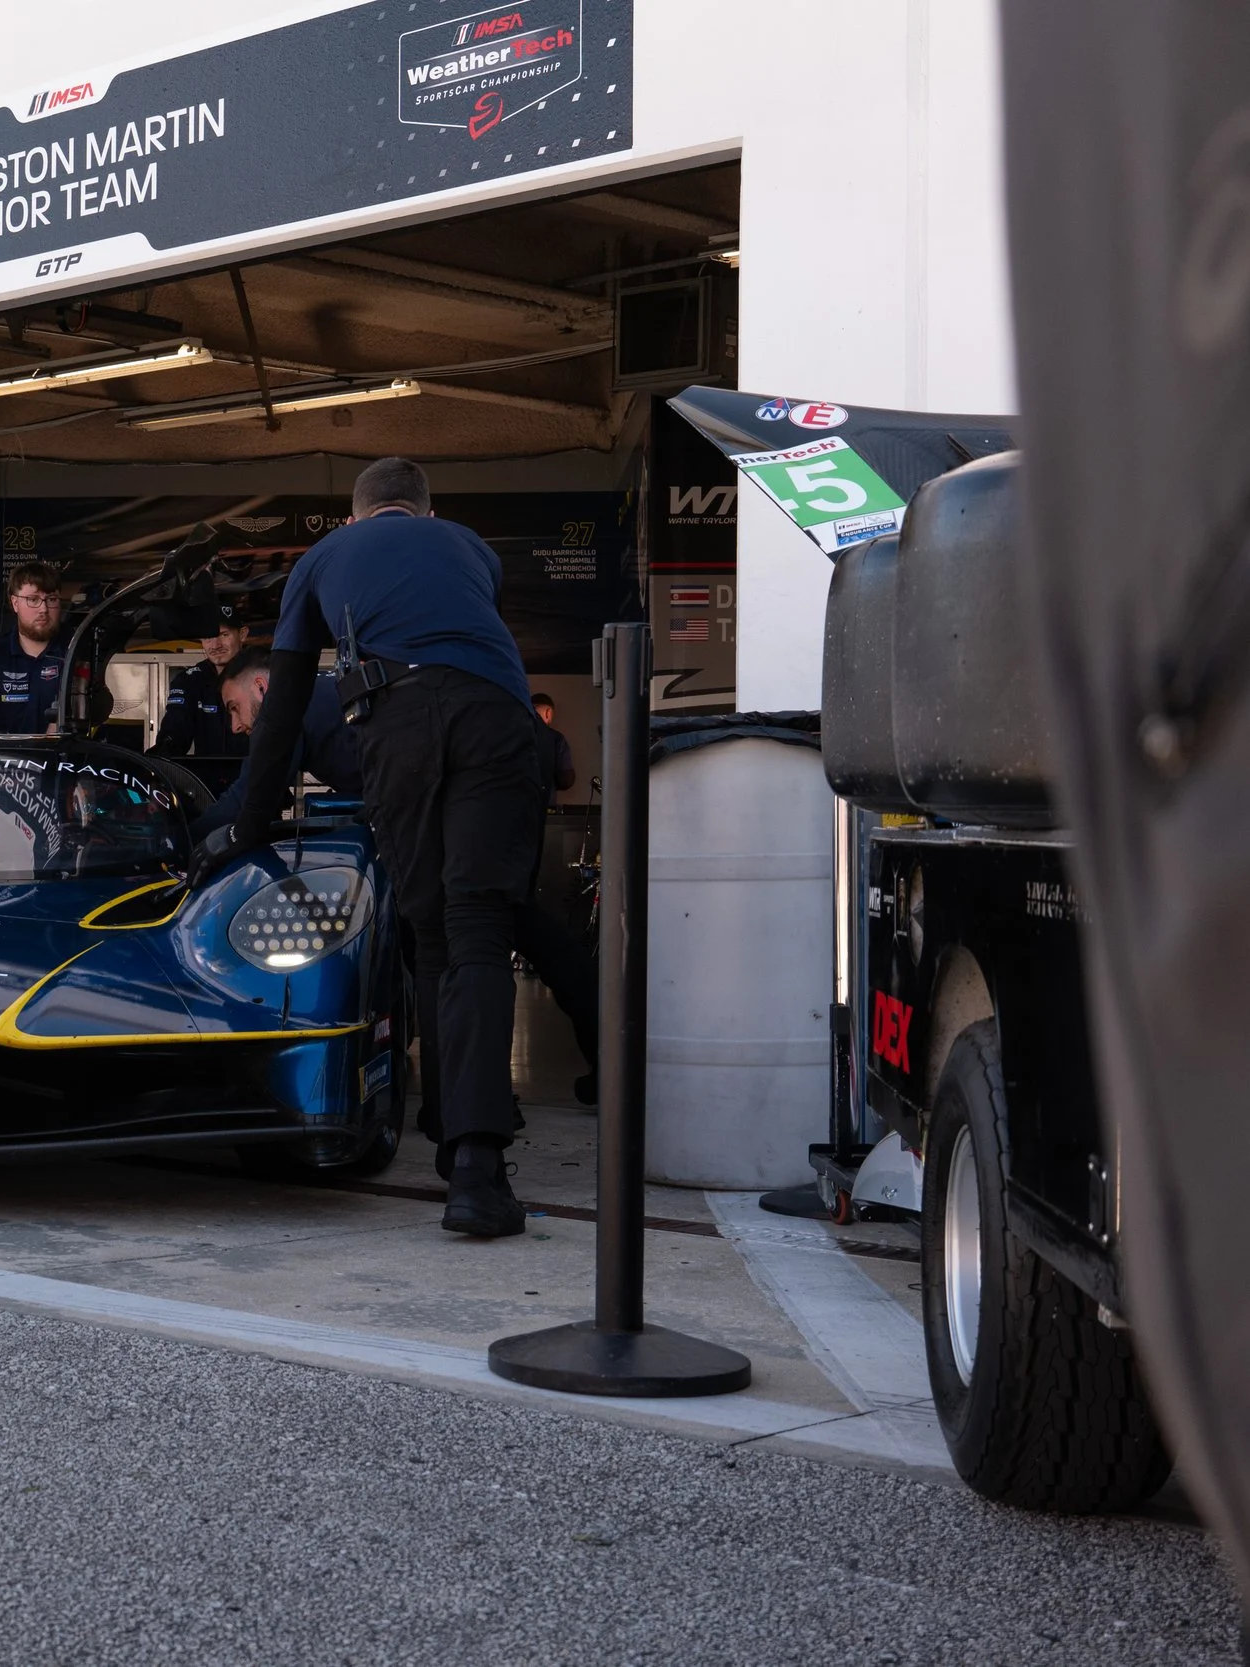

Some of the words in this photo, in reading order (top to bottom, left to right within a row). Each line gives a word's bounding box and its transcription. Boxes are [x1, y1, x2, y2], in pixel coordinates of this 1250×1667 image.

[474, 12, 524, 40] IMSA
[407, 29, 572, 86] WeatherTech
[480, 62, 562, 89] CHAMPIONSHIP
[48, 82, 94, 109] IMSA
[85, 98, 225, 171] MARTIN
[60, 162, 158, 220] TEAM
[35, 252, 82, 278] GTP
[801, 404, 835, 426] E
[732, 441, 834, 466] therTech
[669, 485, 738, 515] WT
[562, 521, 596, 546] 27
[668, 517, 700, 525] WAYNE
[702, 517, 736, 525] TAYLOR
[4, 526, 36, 551] 23
[56, 761, 172, 811] RACING
[872, 989, 914, 1075] DEX
